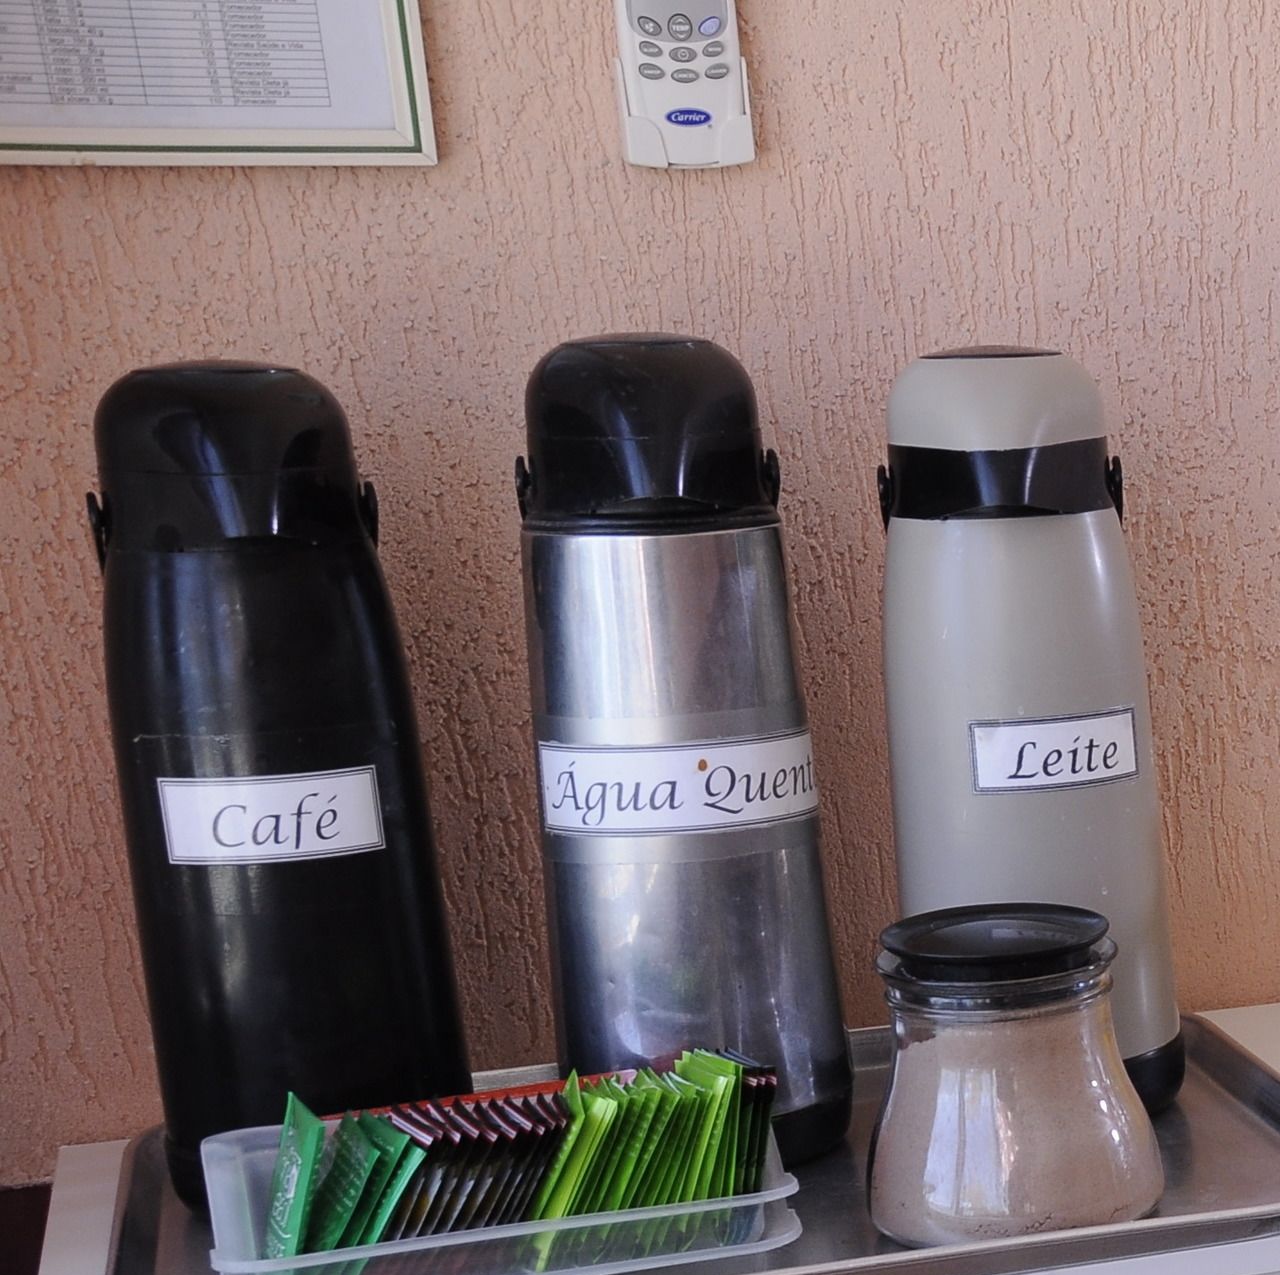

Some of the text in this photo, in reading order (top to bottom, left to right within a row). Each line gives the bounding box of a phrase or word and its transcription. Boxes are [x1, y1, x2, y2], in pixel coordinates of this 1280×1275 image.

[671, 112, 706, 122] Carrier
[1006, 735, 1120, 780] Leite
[552, 755, 817, 826] Água Quent
[213, 792, 341, 850] Café
